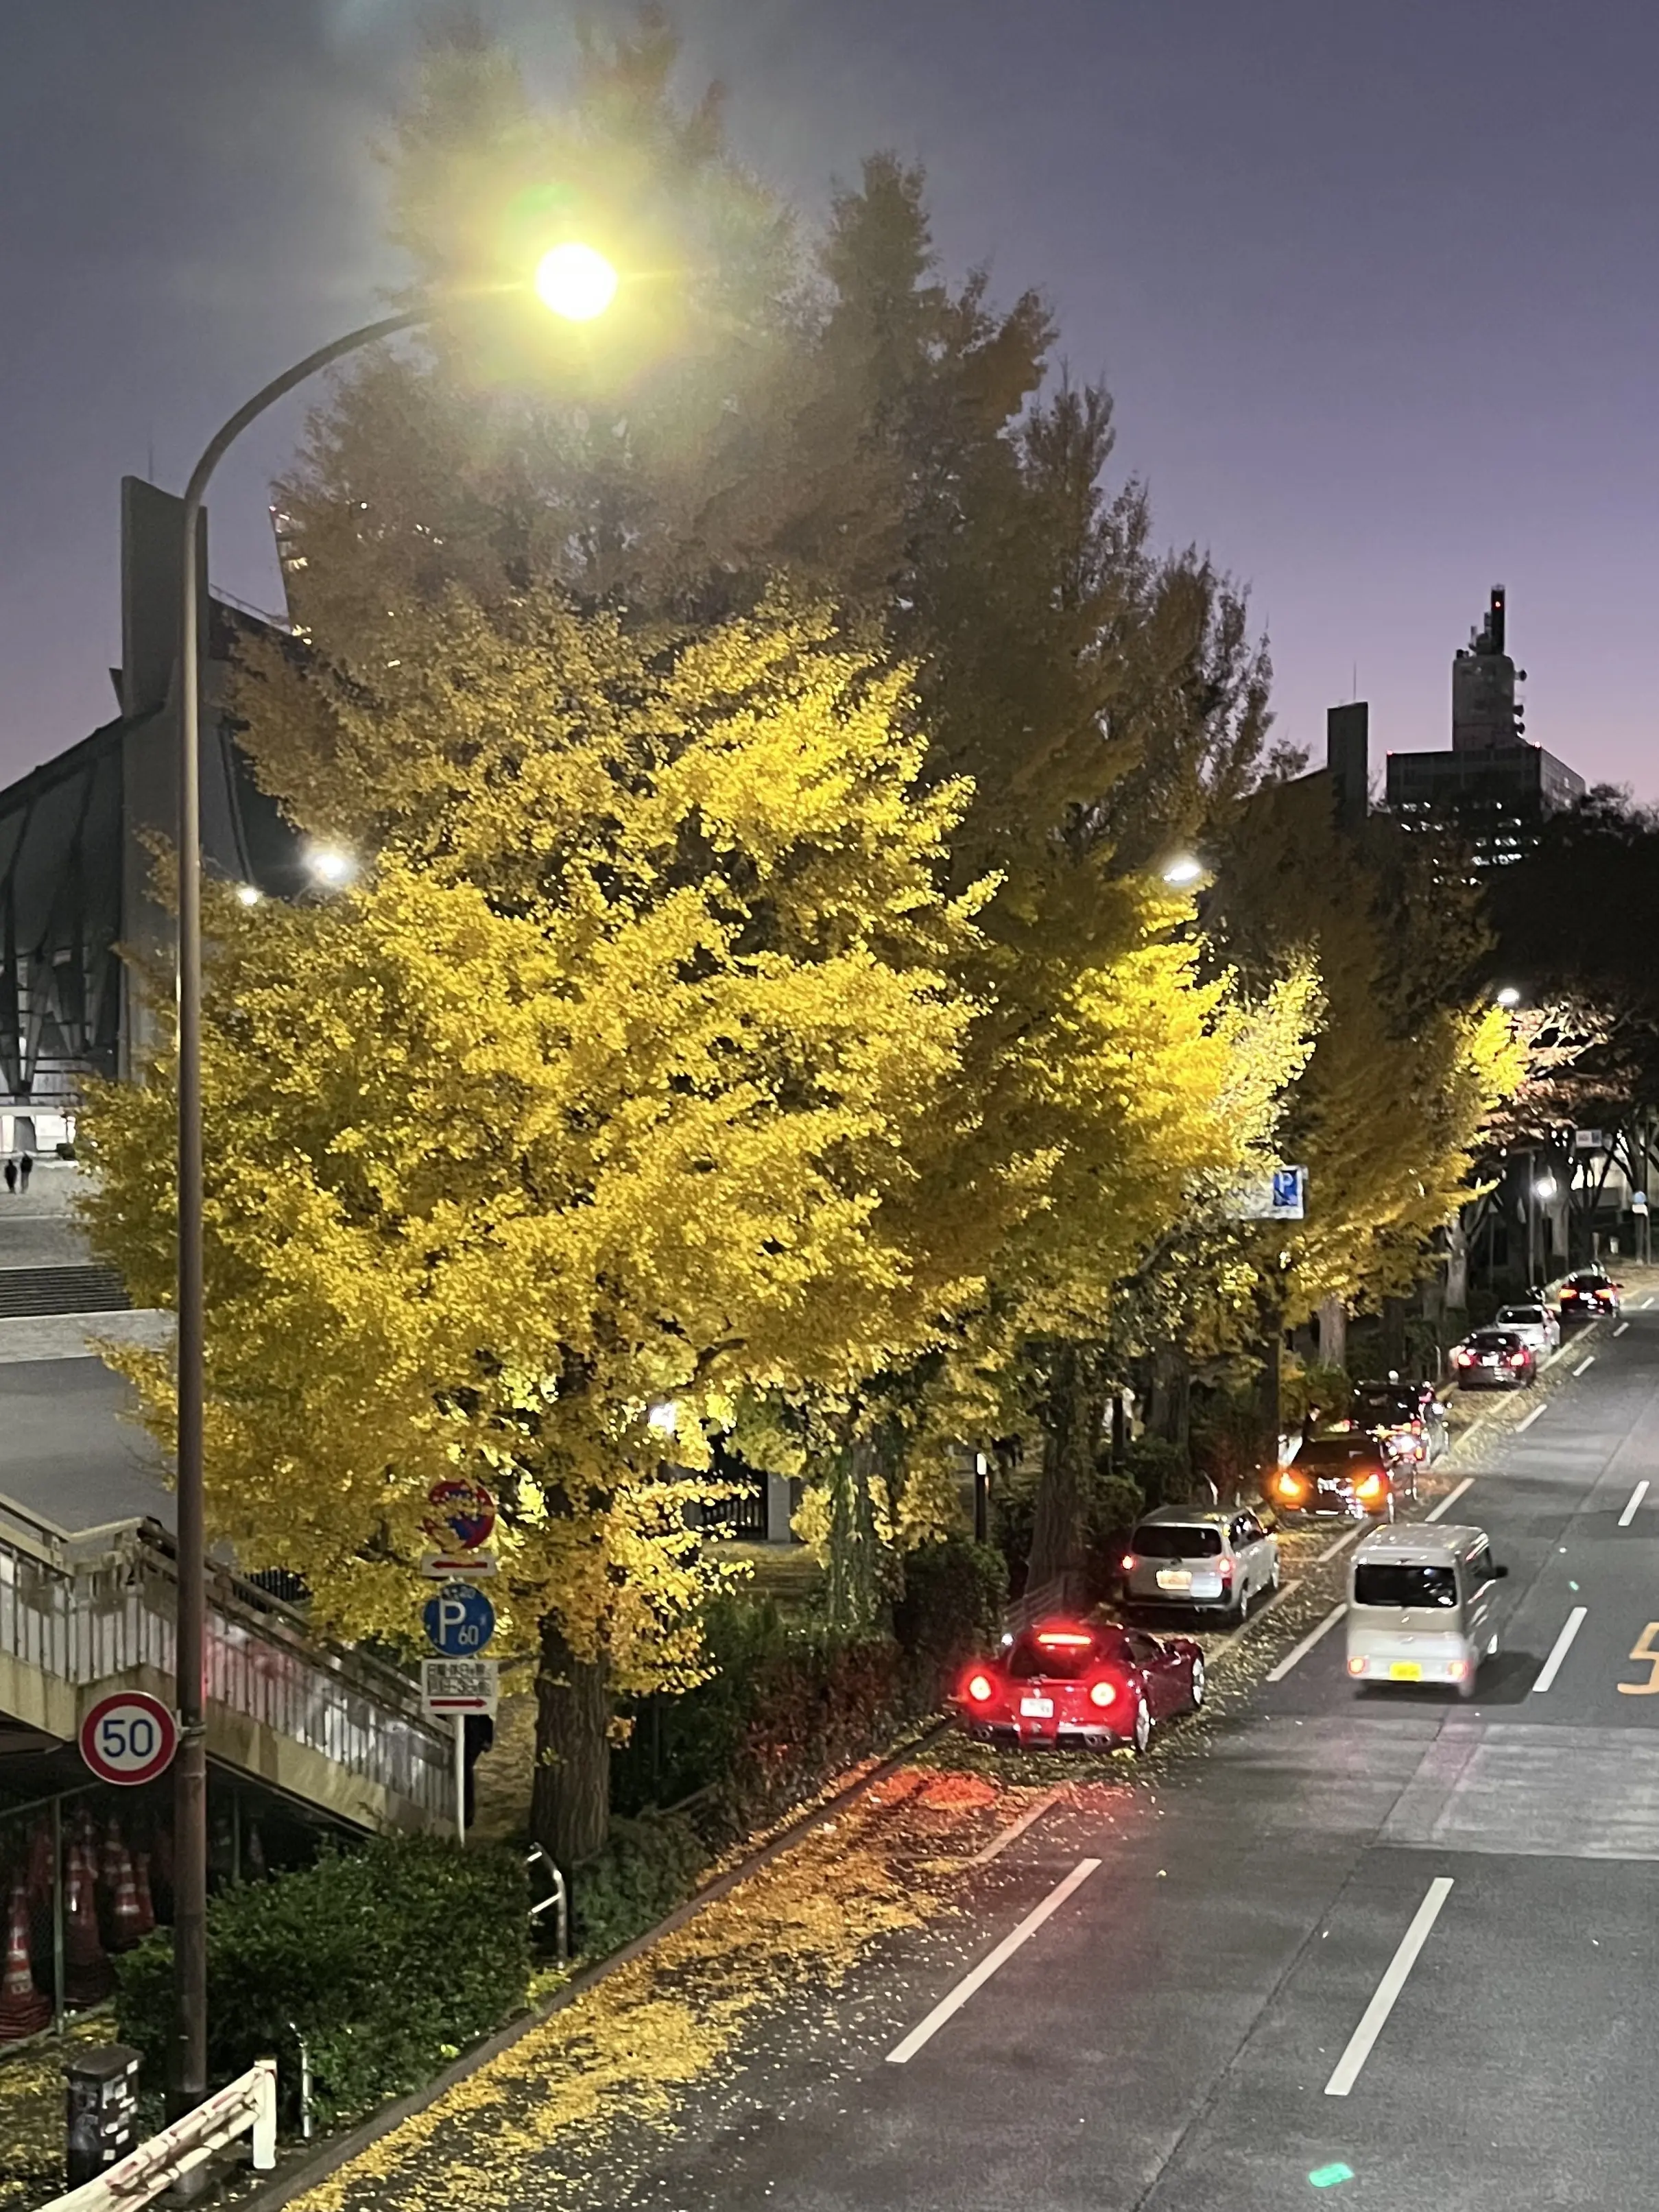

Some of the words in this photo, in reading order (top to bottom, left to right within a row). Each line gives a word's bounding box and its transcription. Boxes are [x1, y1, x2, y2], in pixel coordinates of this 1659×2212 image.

[1278, 1170, 1293, 1194] P
[440, 1599, 466, 1645] P
[458, 1625, 479, 1645] 60
[103, 1719, 153, 1757] 50
